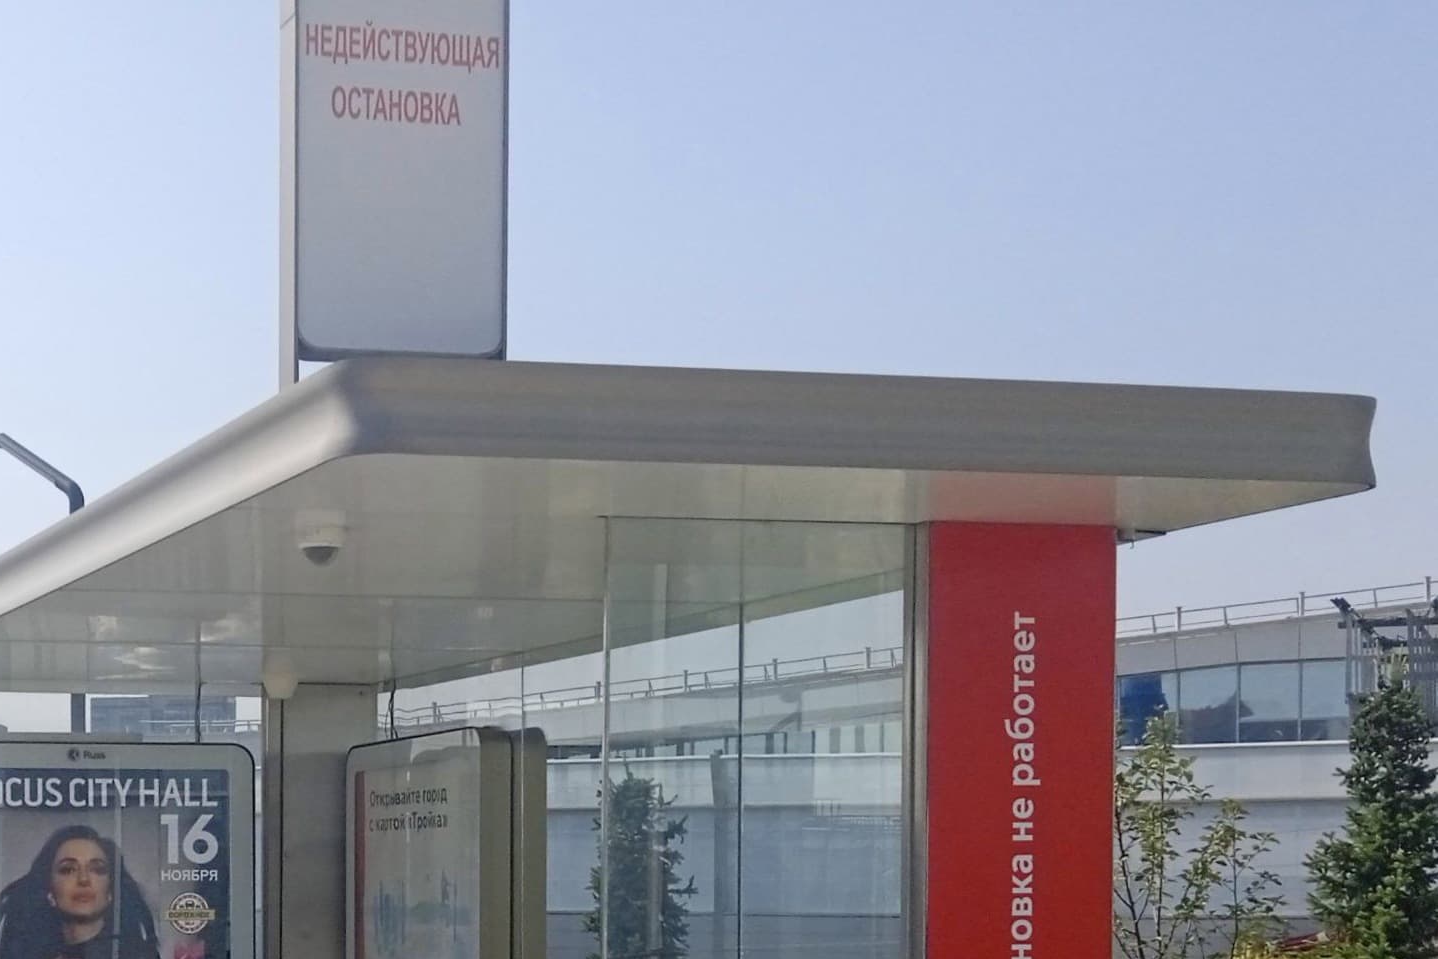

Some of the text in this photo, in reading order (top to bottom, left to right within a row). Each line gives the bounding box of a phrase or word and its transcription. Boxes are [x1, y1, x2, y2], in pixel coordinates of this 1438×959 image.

[305, 20, 500, 73] НЕДЕЙСТВУЮЩАЯ
[331, 85, 461, 126] ОСТАНОВКА
[1004, 611, 1040, 787] работает
[69, 778, 133, 807] CITY
[138, 778, 218, 807] HALL
[161, 814, 218, 864] 16
[1012, 797, 1034, 842] не
[161, 870, 218, 882] НОЯБРЯ
